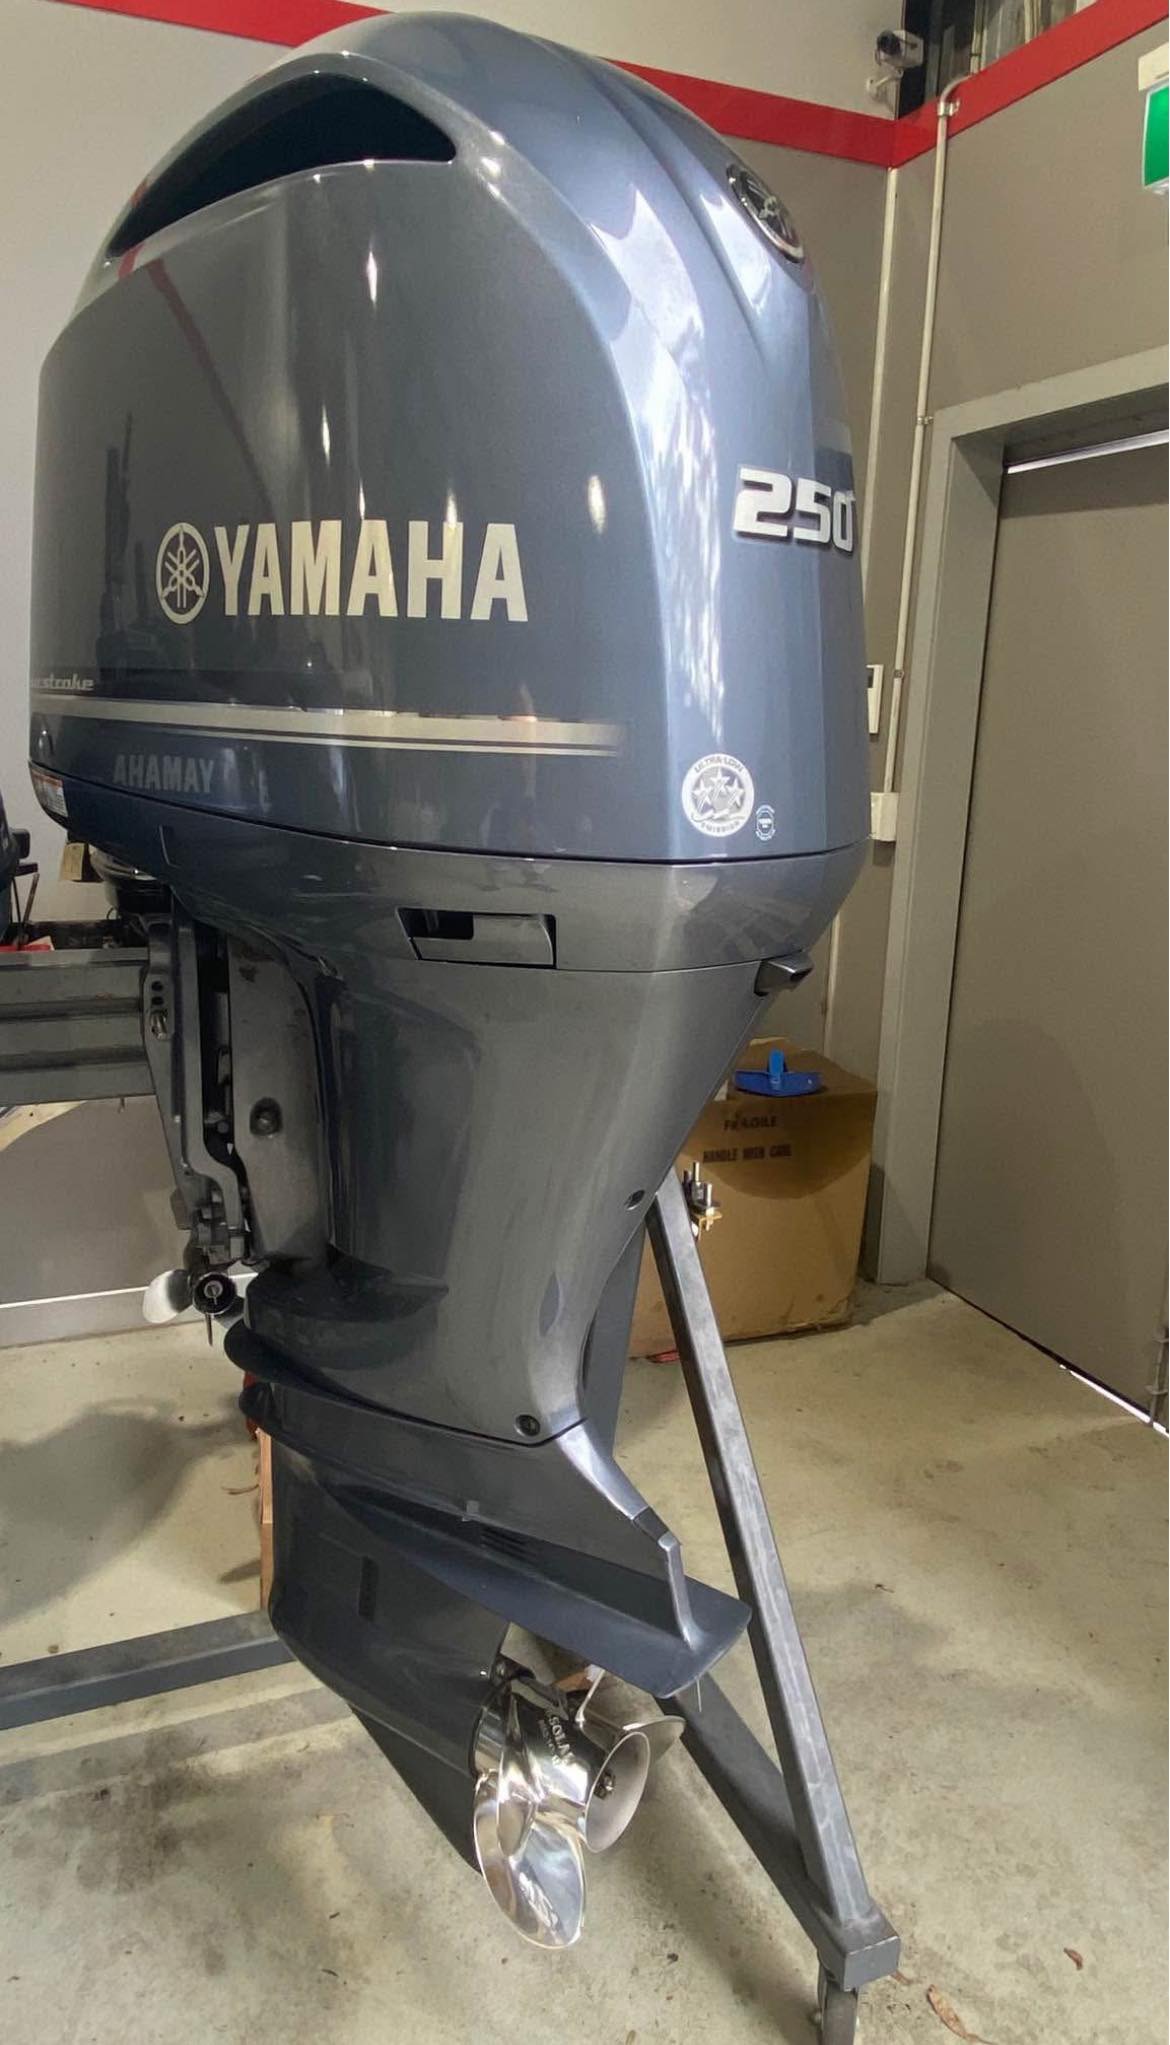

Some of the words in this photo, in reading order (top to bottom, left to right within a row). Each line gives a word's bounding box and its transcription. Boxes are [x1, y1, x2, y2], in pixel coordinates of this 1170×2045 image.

[733, 467, 856, 553] 250
[214, 519, 529, 622] YAMAHA
[694, 756, 721, 773] ULTRA
[723, 1116, 777, 1131] FRAGILE
